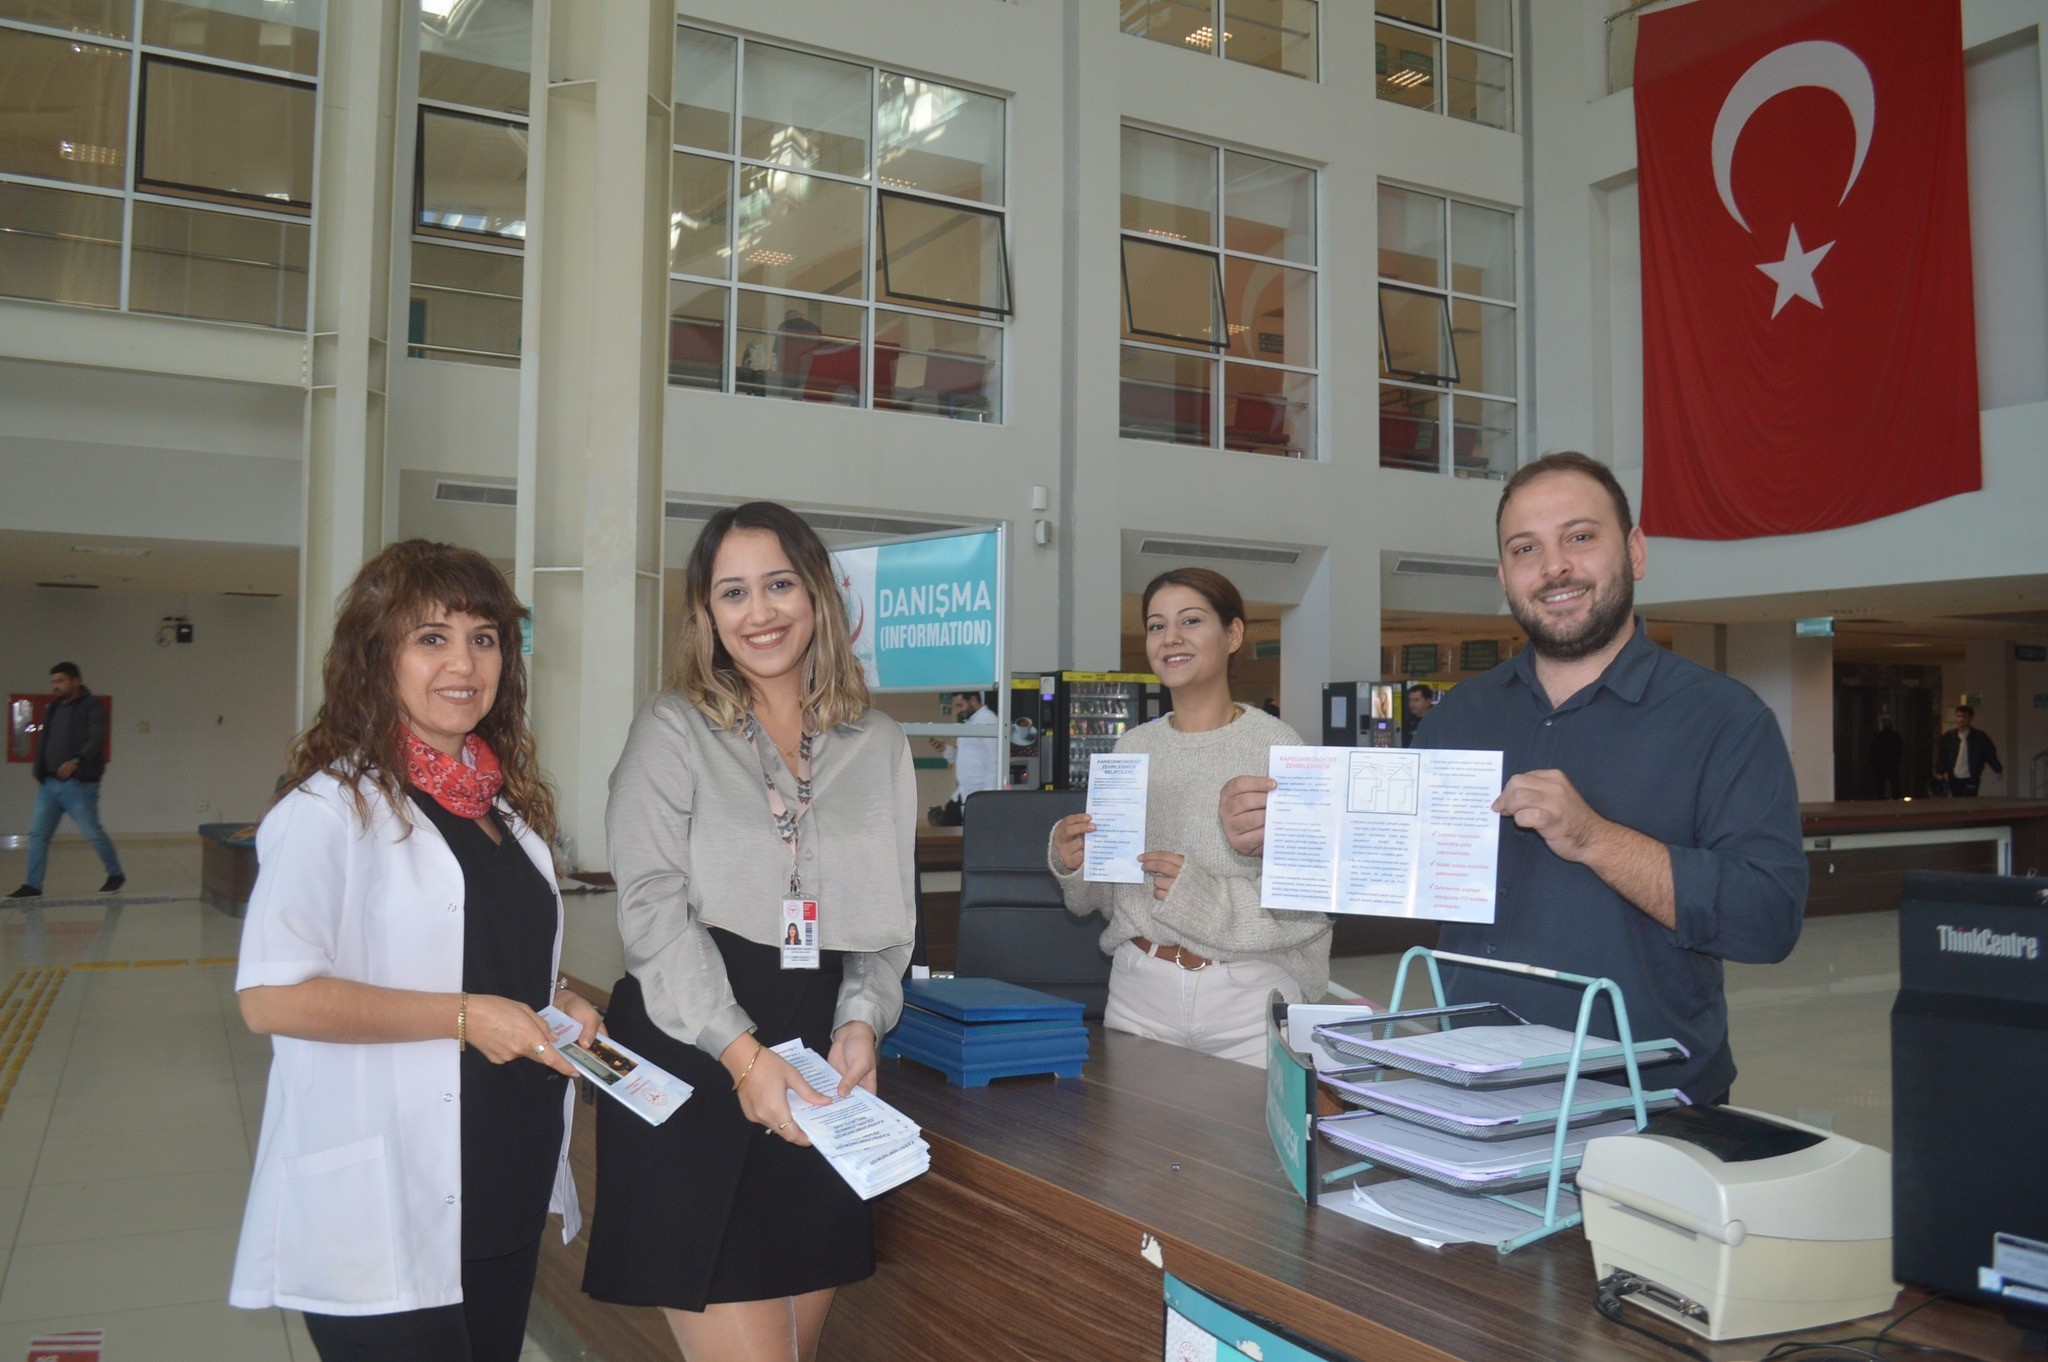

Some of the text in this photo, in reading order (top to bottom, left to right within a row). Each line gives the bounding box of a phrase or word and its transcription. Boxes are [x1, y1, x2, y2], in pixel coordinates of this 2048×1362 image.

[879, 580, 991, 618] DANIŞMA
[880, 620, 991, 651] (INFORMATION)
[1936, 924, 2039, 960] ThinkCentre
